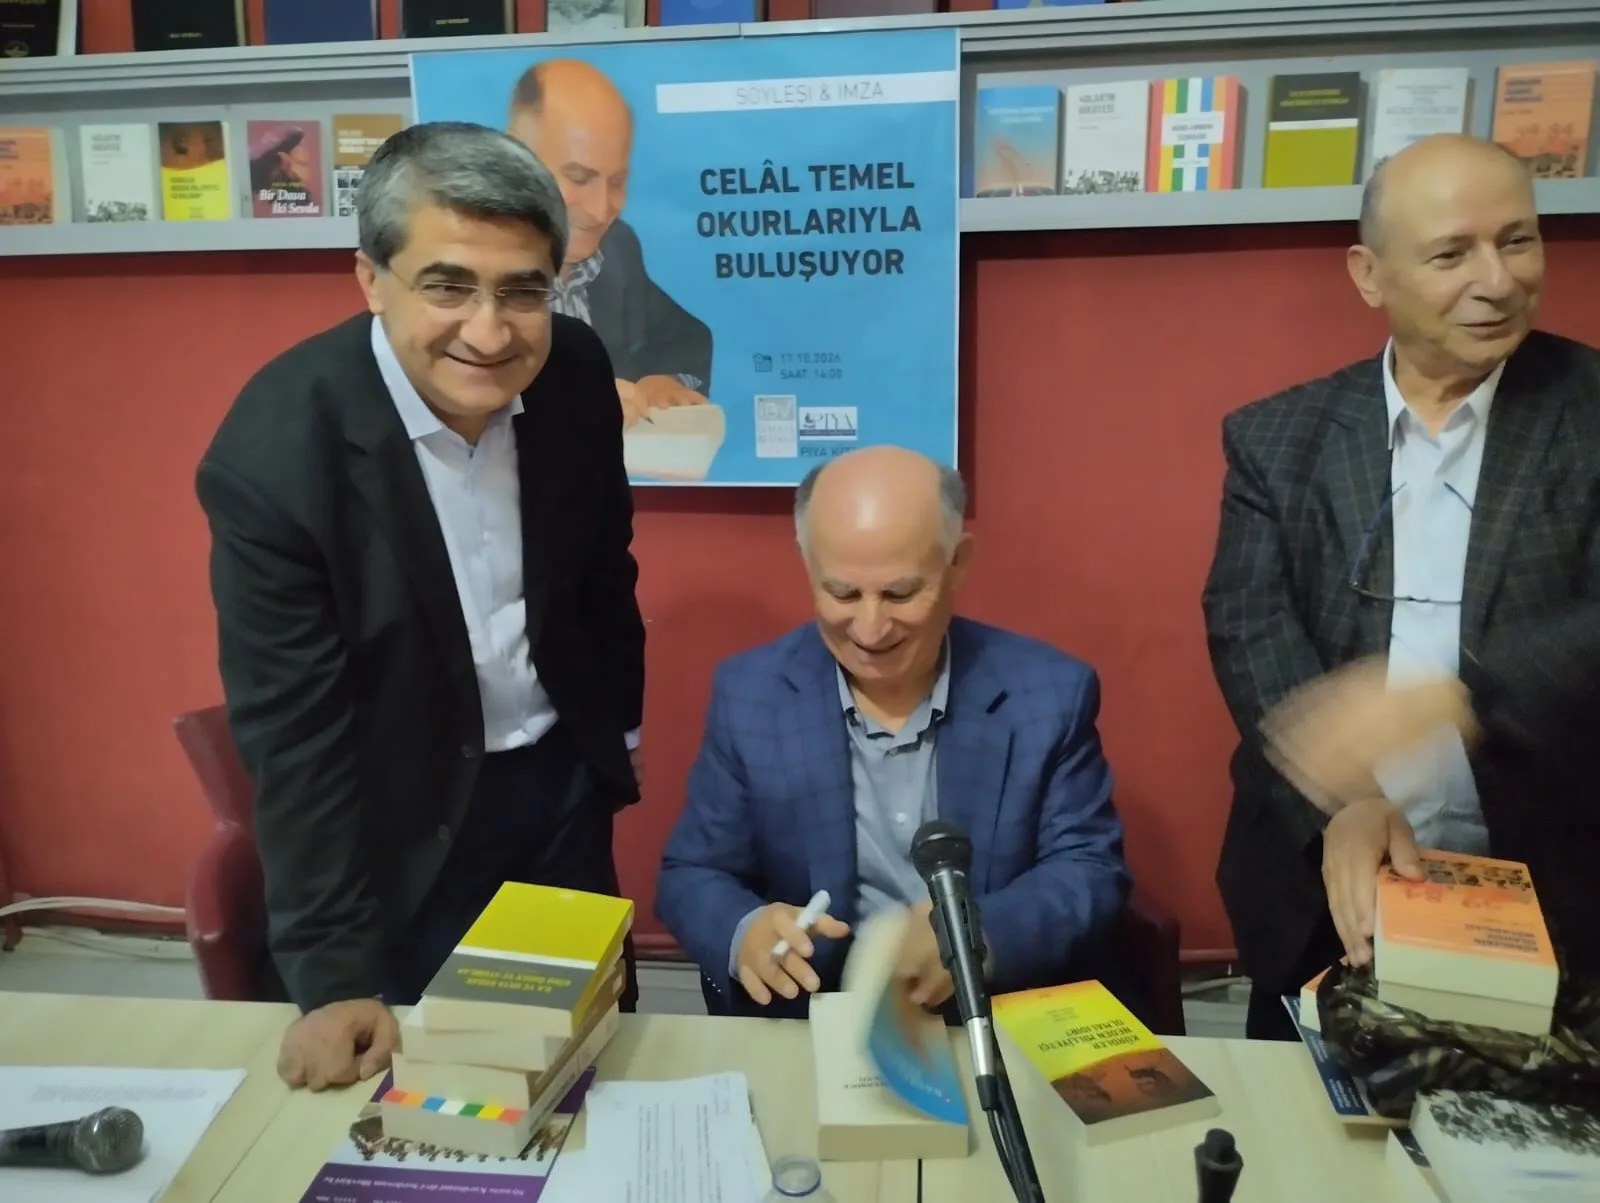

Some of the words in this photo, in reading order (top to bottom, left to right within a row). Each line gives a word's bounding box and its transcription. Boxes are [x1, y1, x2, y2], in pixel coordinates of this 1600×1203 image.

[819, 83, 831, 102] &
[700, 159, 800, 195] CELÂL
[808, 161, 915, 192] TEMEL
[696, 205, 922, 238] OKURLARIYLA
[715, 249, 905, 282] BULUŞUYOR
